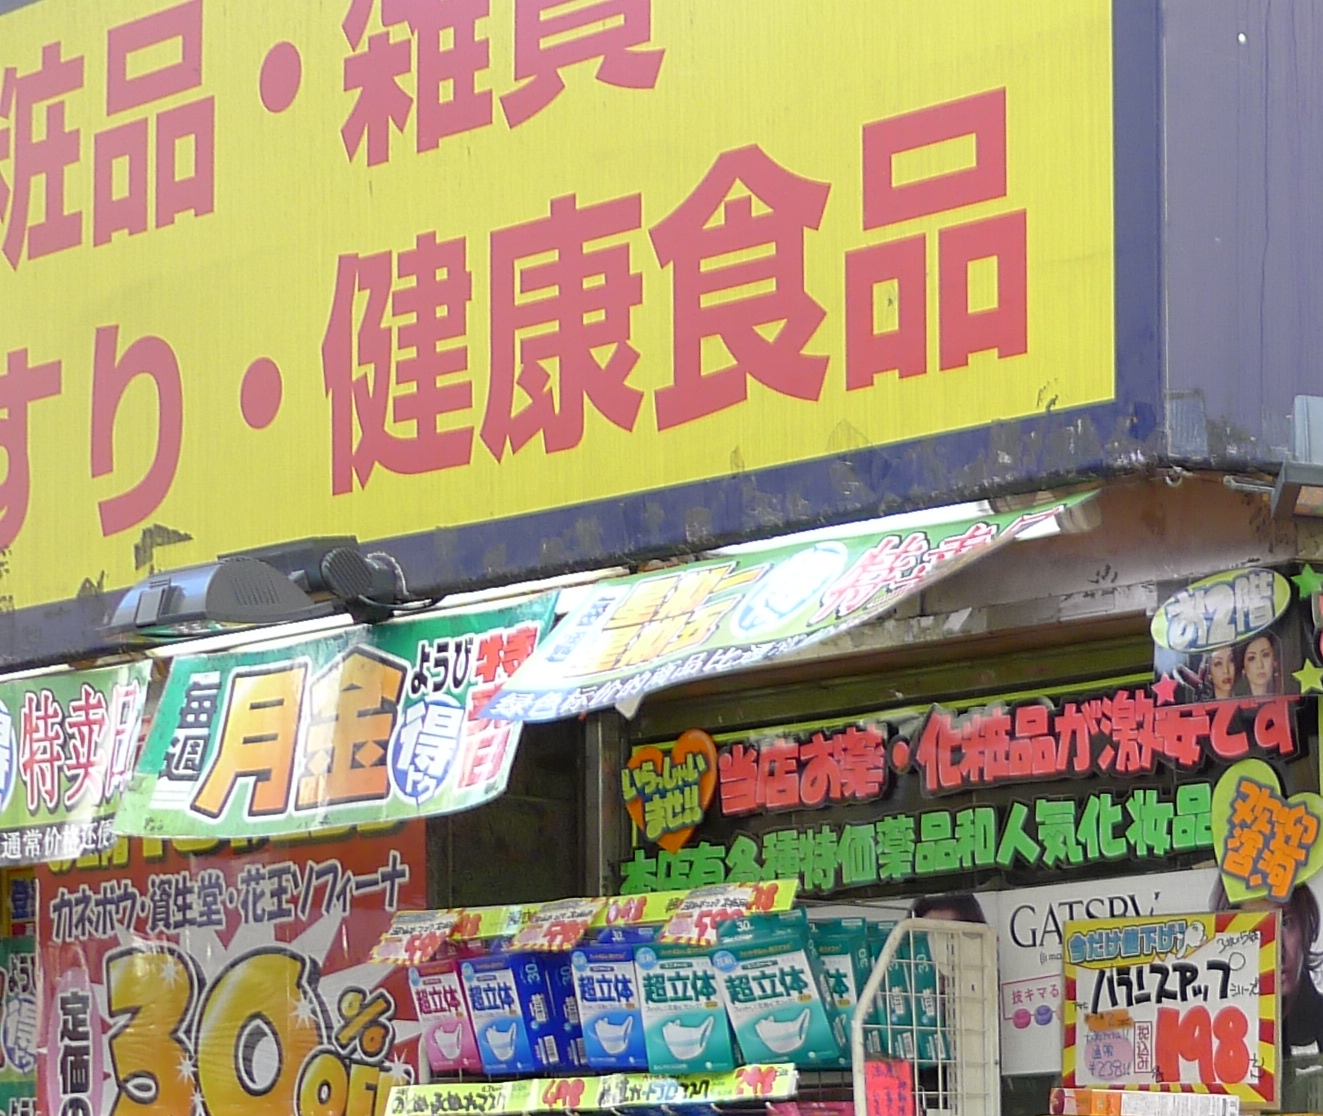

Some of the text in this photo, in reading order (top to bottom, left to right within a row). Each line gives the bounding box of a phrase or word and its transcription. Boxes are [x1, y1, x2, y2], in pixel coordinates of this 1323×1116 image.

[411, 636, 474, 694] ようび
[193, 646, 406, 818] 月金
[1155, 1004, 1251, 1085] 198
